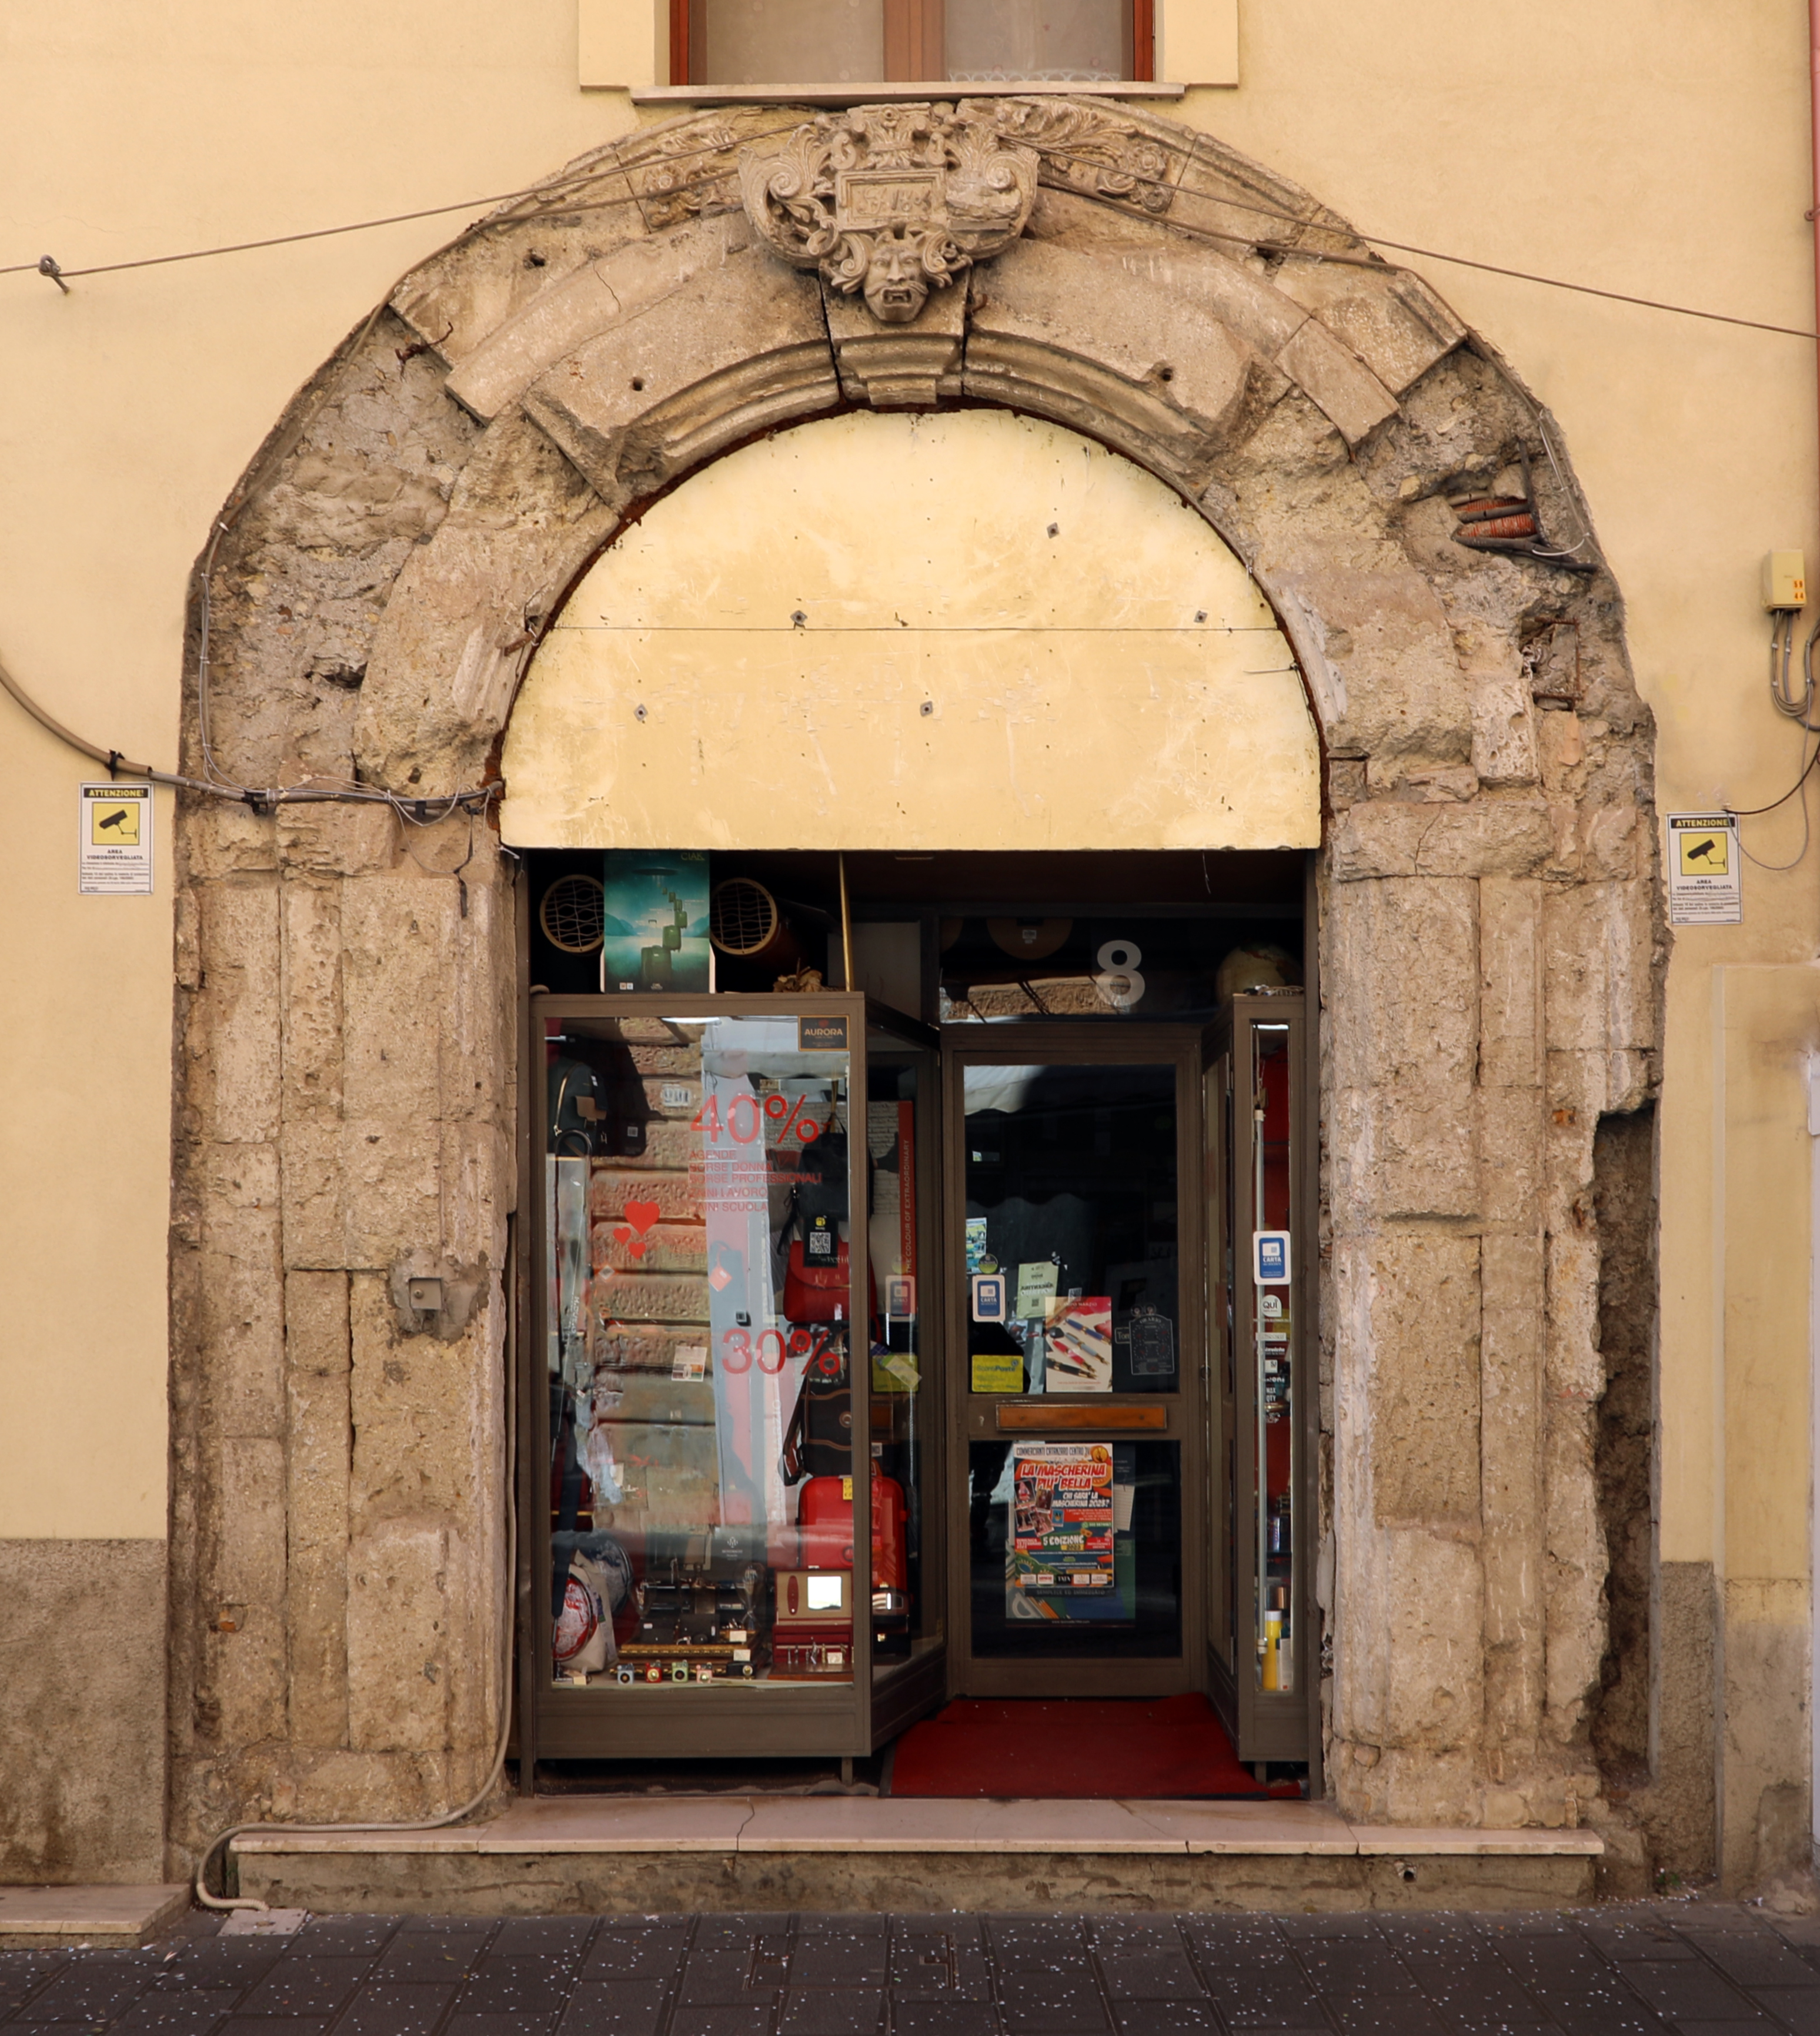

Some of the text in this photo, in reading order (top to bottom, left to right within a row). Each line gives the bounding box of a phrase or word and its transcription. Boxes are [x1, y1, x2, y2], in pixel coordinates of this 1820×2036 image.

[680, 852, 705, 861] CIAK
[1096, 940, 1146, 1007] 8
[804, 1028, 843, 1036] AURORA
[690, 1094, 819, 1144] 40%
[689, 1150, 737, 1159] AGENDE
[689, 1162, 773, 1172] BORSE DONNA
[689, 1173, 822, 1184] BORSE PROFESSIONALI
[689, 1187, 768, 1198] ZAINI LAVORO
[722, 1202, 767, 1212] SCUOLA
[904, 1210, 911, 1222] OF
[722, 1328, 841, 1376] 30%
[1016, 1447, 1046, 1456] COMMERCIANTI
[1046, 1447, 1068, 1456] CATANZARO
[1021, 1463, 1107, 1477] LA MASCHERINA
[1059, 1477, 1093, 1491] BELLA
[1043, 1536, 1048, 1546] 5
[1049, 1534, 1085, 1546] EDIZIONE
